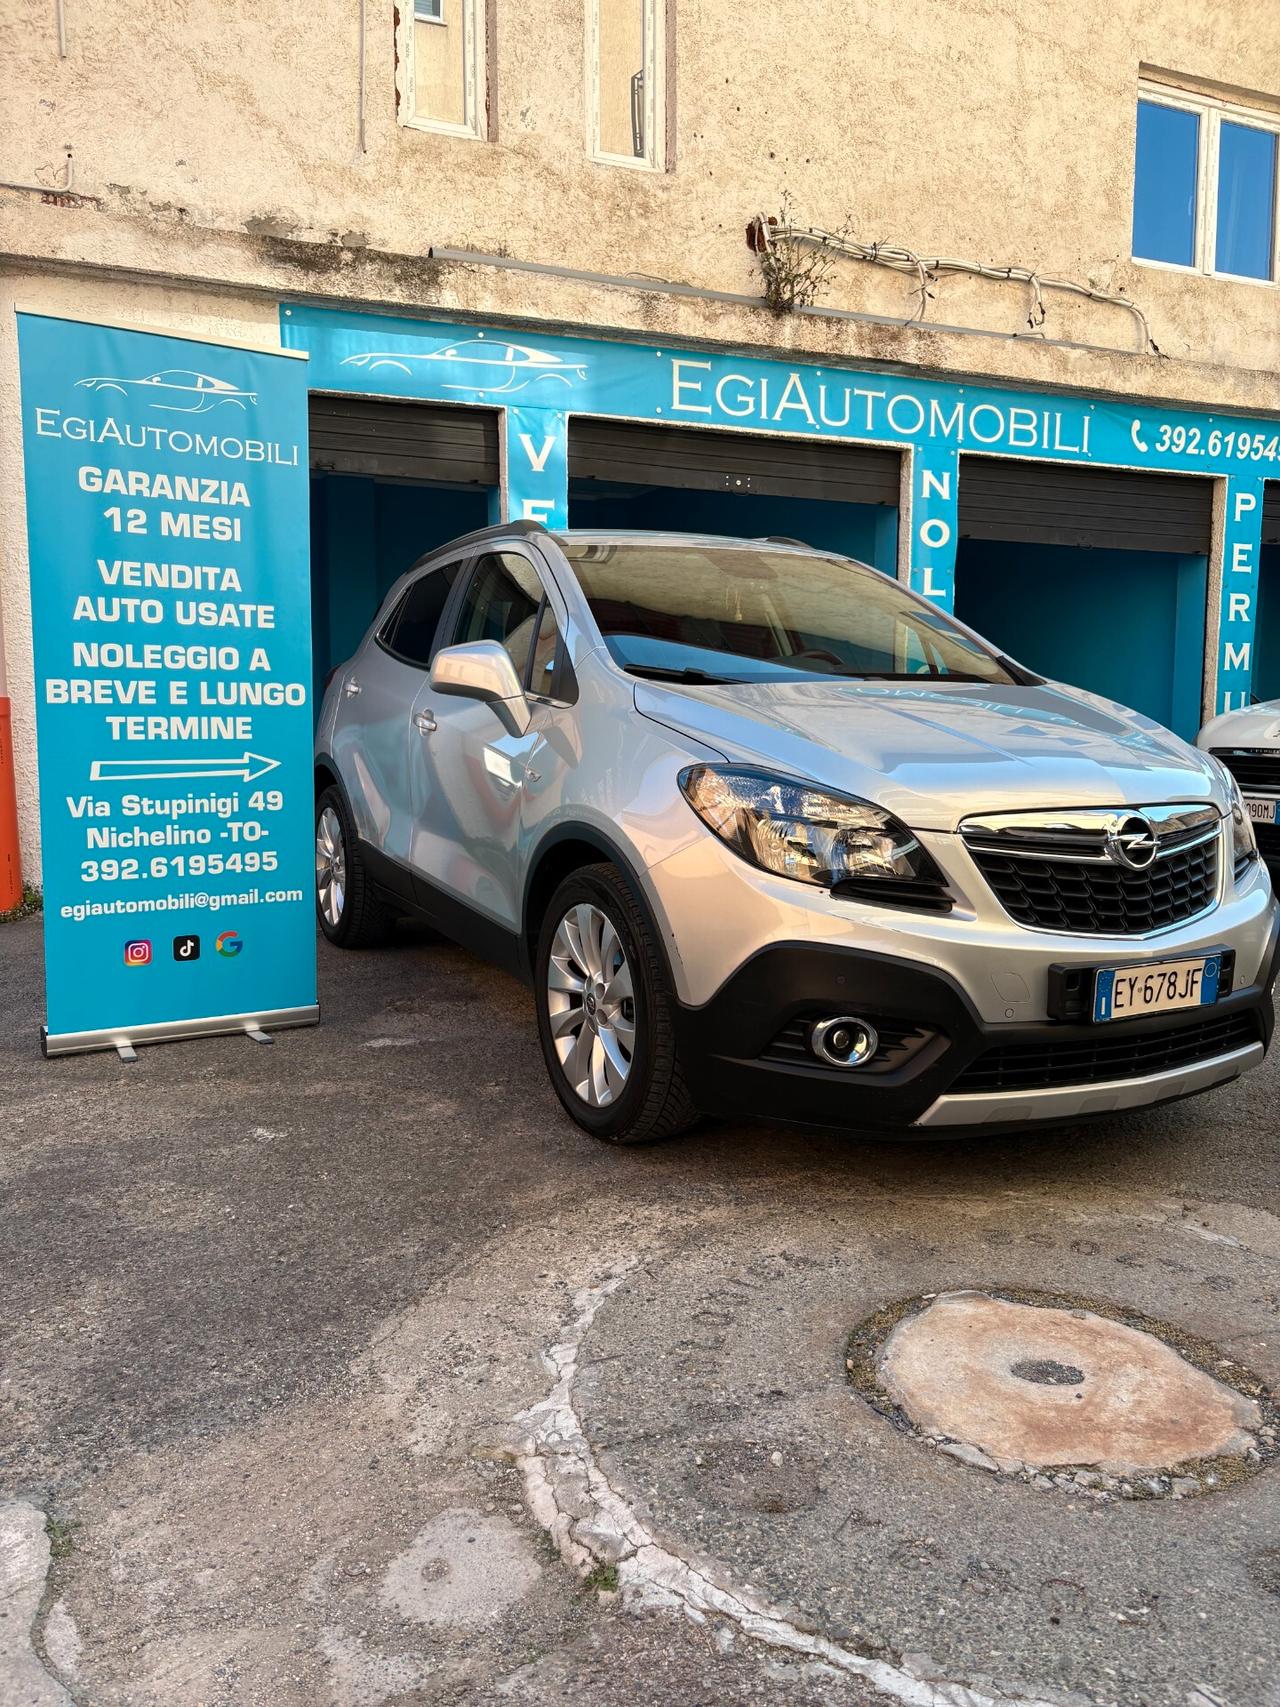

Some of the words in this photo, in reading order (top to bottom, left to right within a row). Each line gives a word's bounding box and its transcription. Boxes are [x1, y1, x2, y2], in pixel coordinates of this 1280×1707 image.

[1155, 424, 1280, 462] 392.61954
[78, 465, 251, 508] GARANZIA
[103, 506, 148, 535] 12
[160, 511, 241, 542] MESI
[97, 559, 242, 592] VENDITA
[73, 595, 164, 624] AUTO
[175, 600, 275, 629] USATE
[73, 642, 240, 671] NOLEGGIO
[249, 647, 271, 672] A
[45, 678, 157, 705] BREVE
[169, 681, 188, 705] E
[200, 681, 306, 706] LUNGO
[105, 716, 253, 740] TERMINE
[66, 795, 111, 818] Via
[121, 792, 239, 820] Stupinigi
[248, 790, 283, 812] 49
[86, 824, 211, 849] Nichelino
[220, 821, 269, 842] -TO-
[81, 851, 278, 882] 392.6195495
[60, 888, 303, 921] egiautomobili@gmail.com
